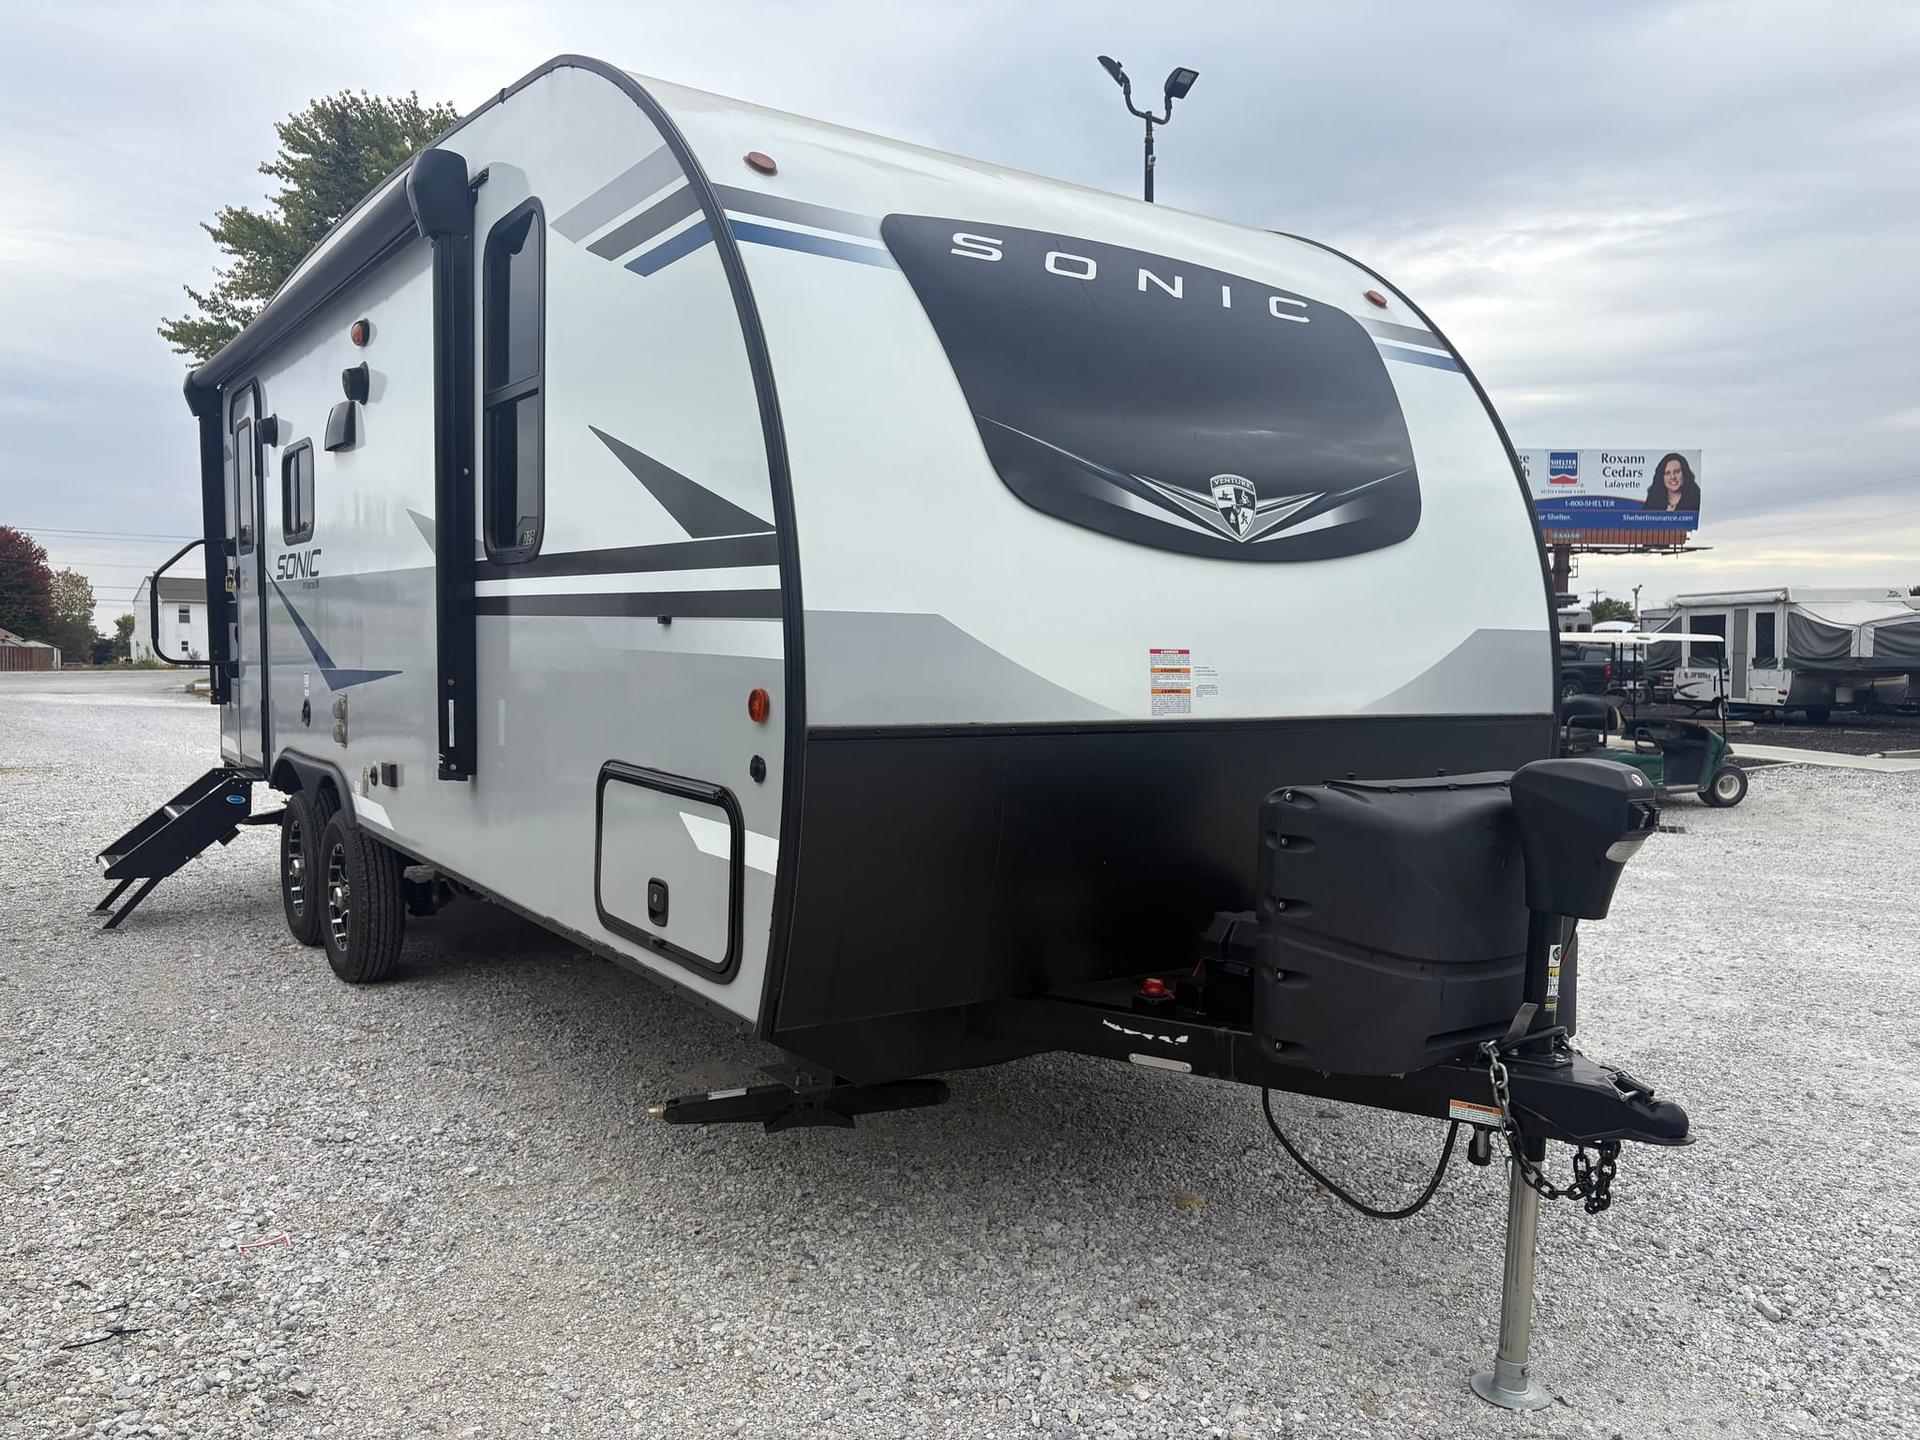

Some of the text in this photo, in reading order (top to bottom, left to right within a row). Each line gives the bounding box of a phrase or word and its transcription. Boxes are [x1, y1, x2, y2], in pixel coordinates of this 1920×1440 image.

[950, 232, 1311, 323] SONIC
[1601, 453, 1645, 464] Roxann
[1602, 466, 1643, 478] Cedars
[1604, 480, 1641, 490] Lafayette
[1547, 512, 1573, 521] Shelter.
[1622, 513, 1694, 522] ShelterInsurance.com
[276, 549, 322, 580] SONIC
